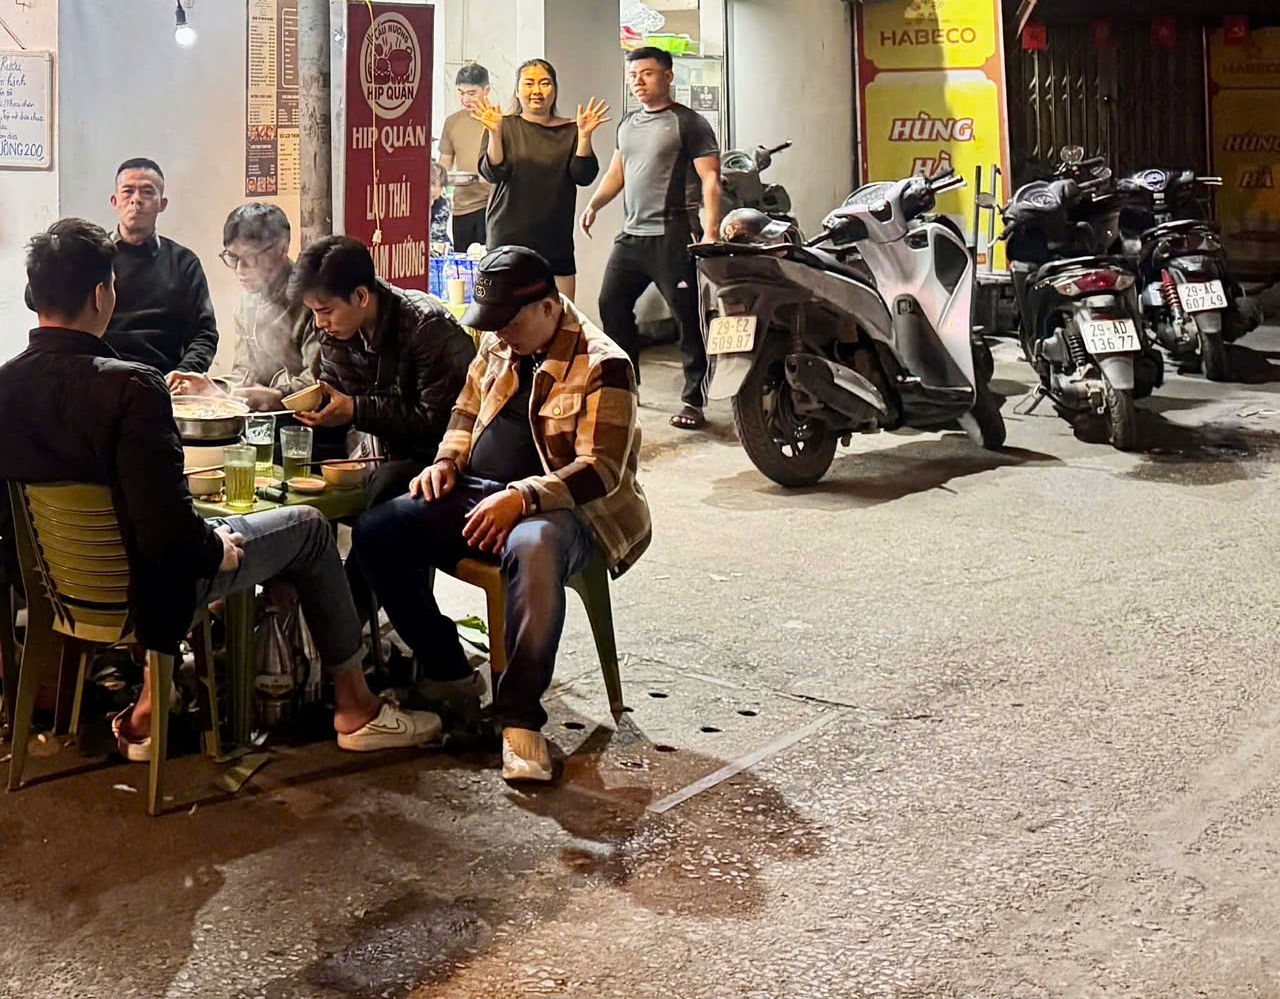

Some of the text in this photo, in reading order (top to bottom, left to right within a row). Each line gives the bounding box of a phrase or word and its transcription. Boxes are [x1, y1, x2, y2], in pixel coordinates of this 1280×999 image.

[880, 27, 976, 46] HABECO
[352, 122, 426, 153] HIP QUÁN
[888, 111, 974, 142] HÙNG
[911, 150, 953, 179] HÀ
[389, 174, 411, 218] THÁI
[391, 234, 425, 279] NƯỚNG
